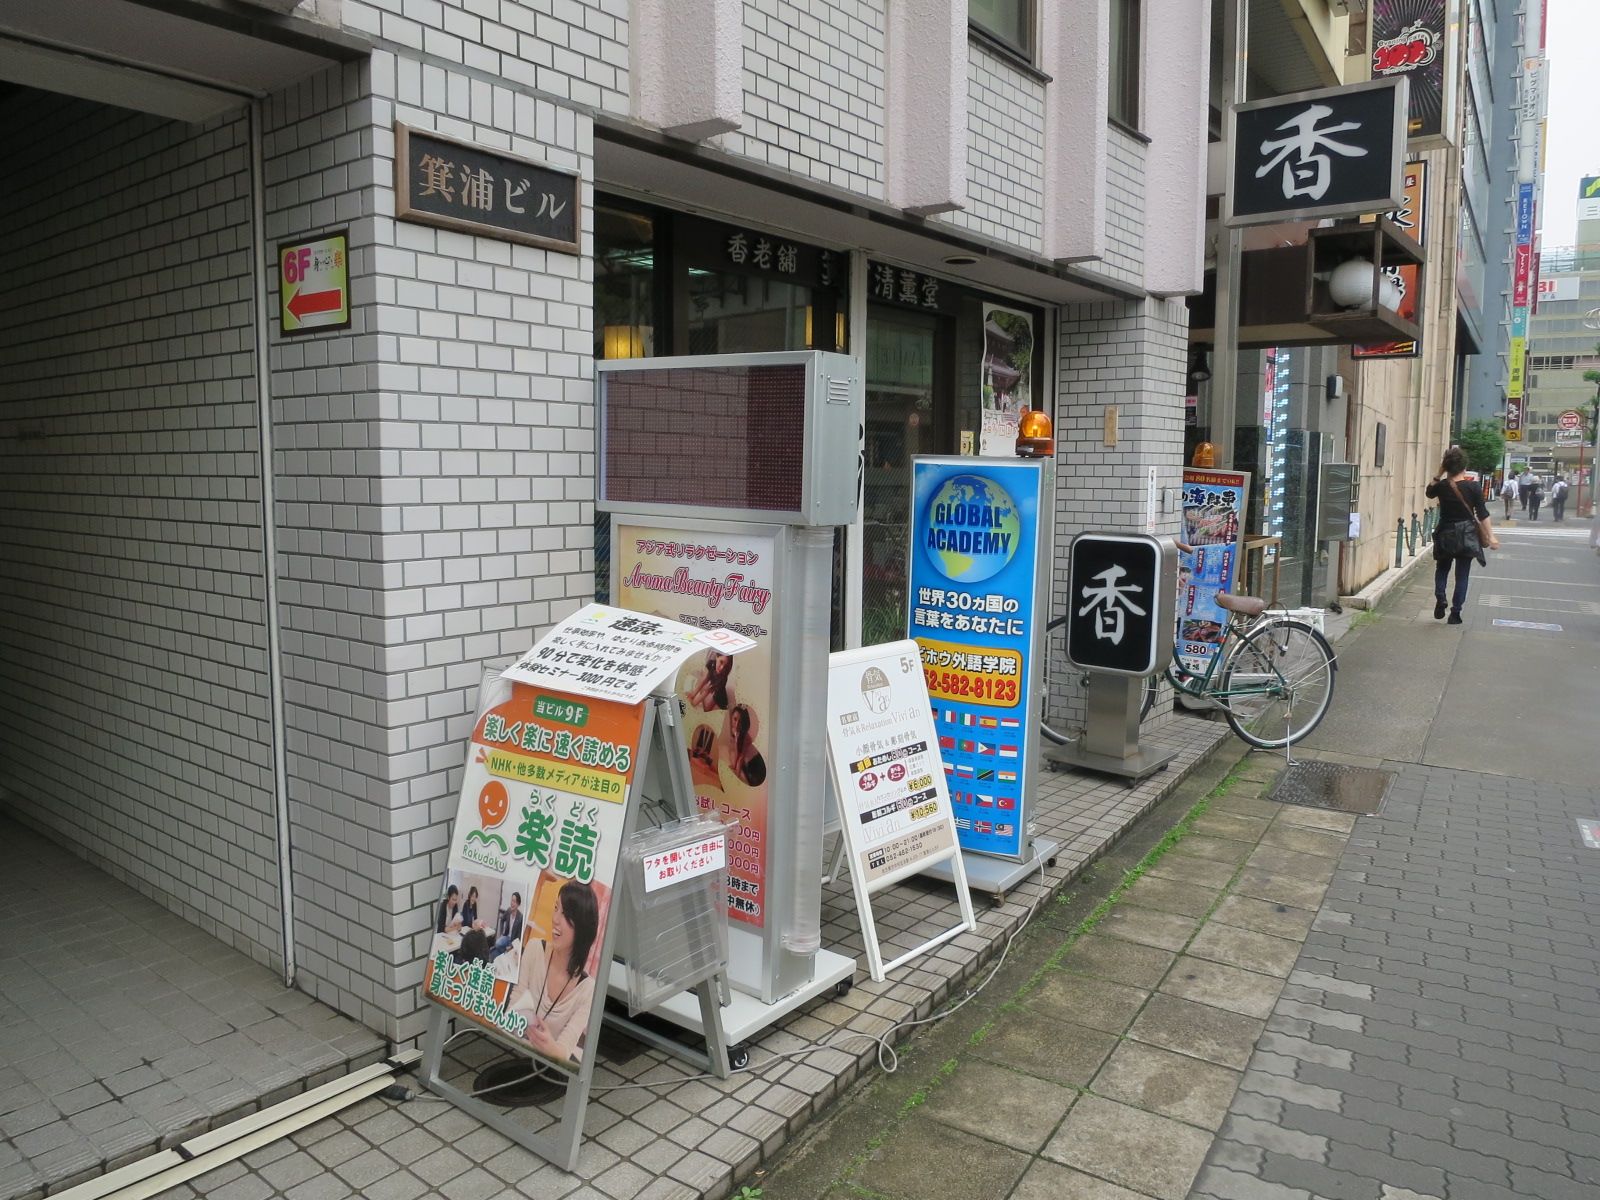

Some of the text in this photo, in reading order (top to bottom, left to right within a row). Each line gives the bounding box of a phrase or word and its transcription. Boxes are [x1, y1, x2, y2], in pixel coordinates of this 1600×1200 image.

[1255, 104, 1369, 200] 香
[418, 153, 567, 220] 箕浦ビル
[284, 247, 312, 285] 6F
[935, 502, 1003, 529] GLOBAL
[635, 539, 760, 566] アジア式リラクゼーション
[927, 527, 1012, 555] ACADEMY
[623, 562, 772, 615] Aroma Beauty Fairy
[1078, 563, 1147, 646] 香
[705, 631, 746, 646] 9F
[914, 608, 1024, 636] 言葉をあなたに
[900, 656, 914, 674] 5F
[1185, 644, 1207, 655] 580
[483, 713, 631, 774] 楽しく 楽に 速く読める
[490, 757, 621, 794] NHK・他多数メディアが注目の
[530, 788, 598, 823] らく どく
[462, 844, 507, 871] Rakudoku
[513, 805, 600, 882] 楽読
[645, 839, 724, 870] フタを開いてご自由に
[658, 856, 713, 880] お取りください
[433, 949, 495, 996] 楽しく速読
